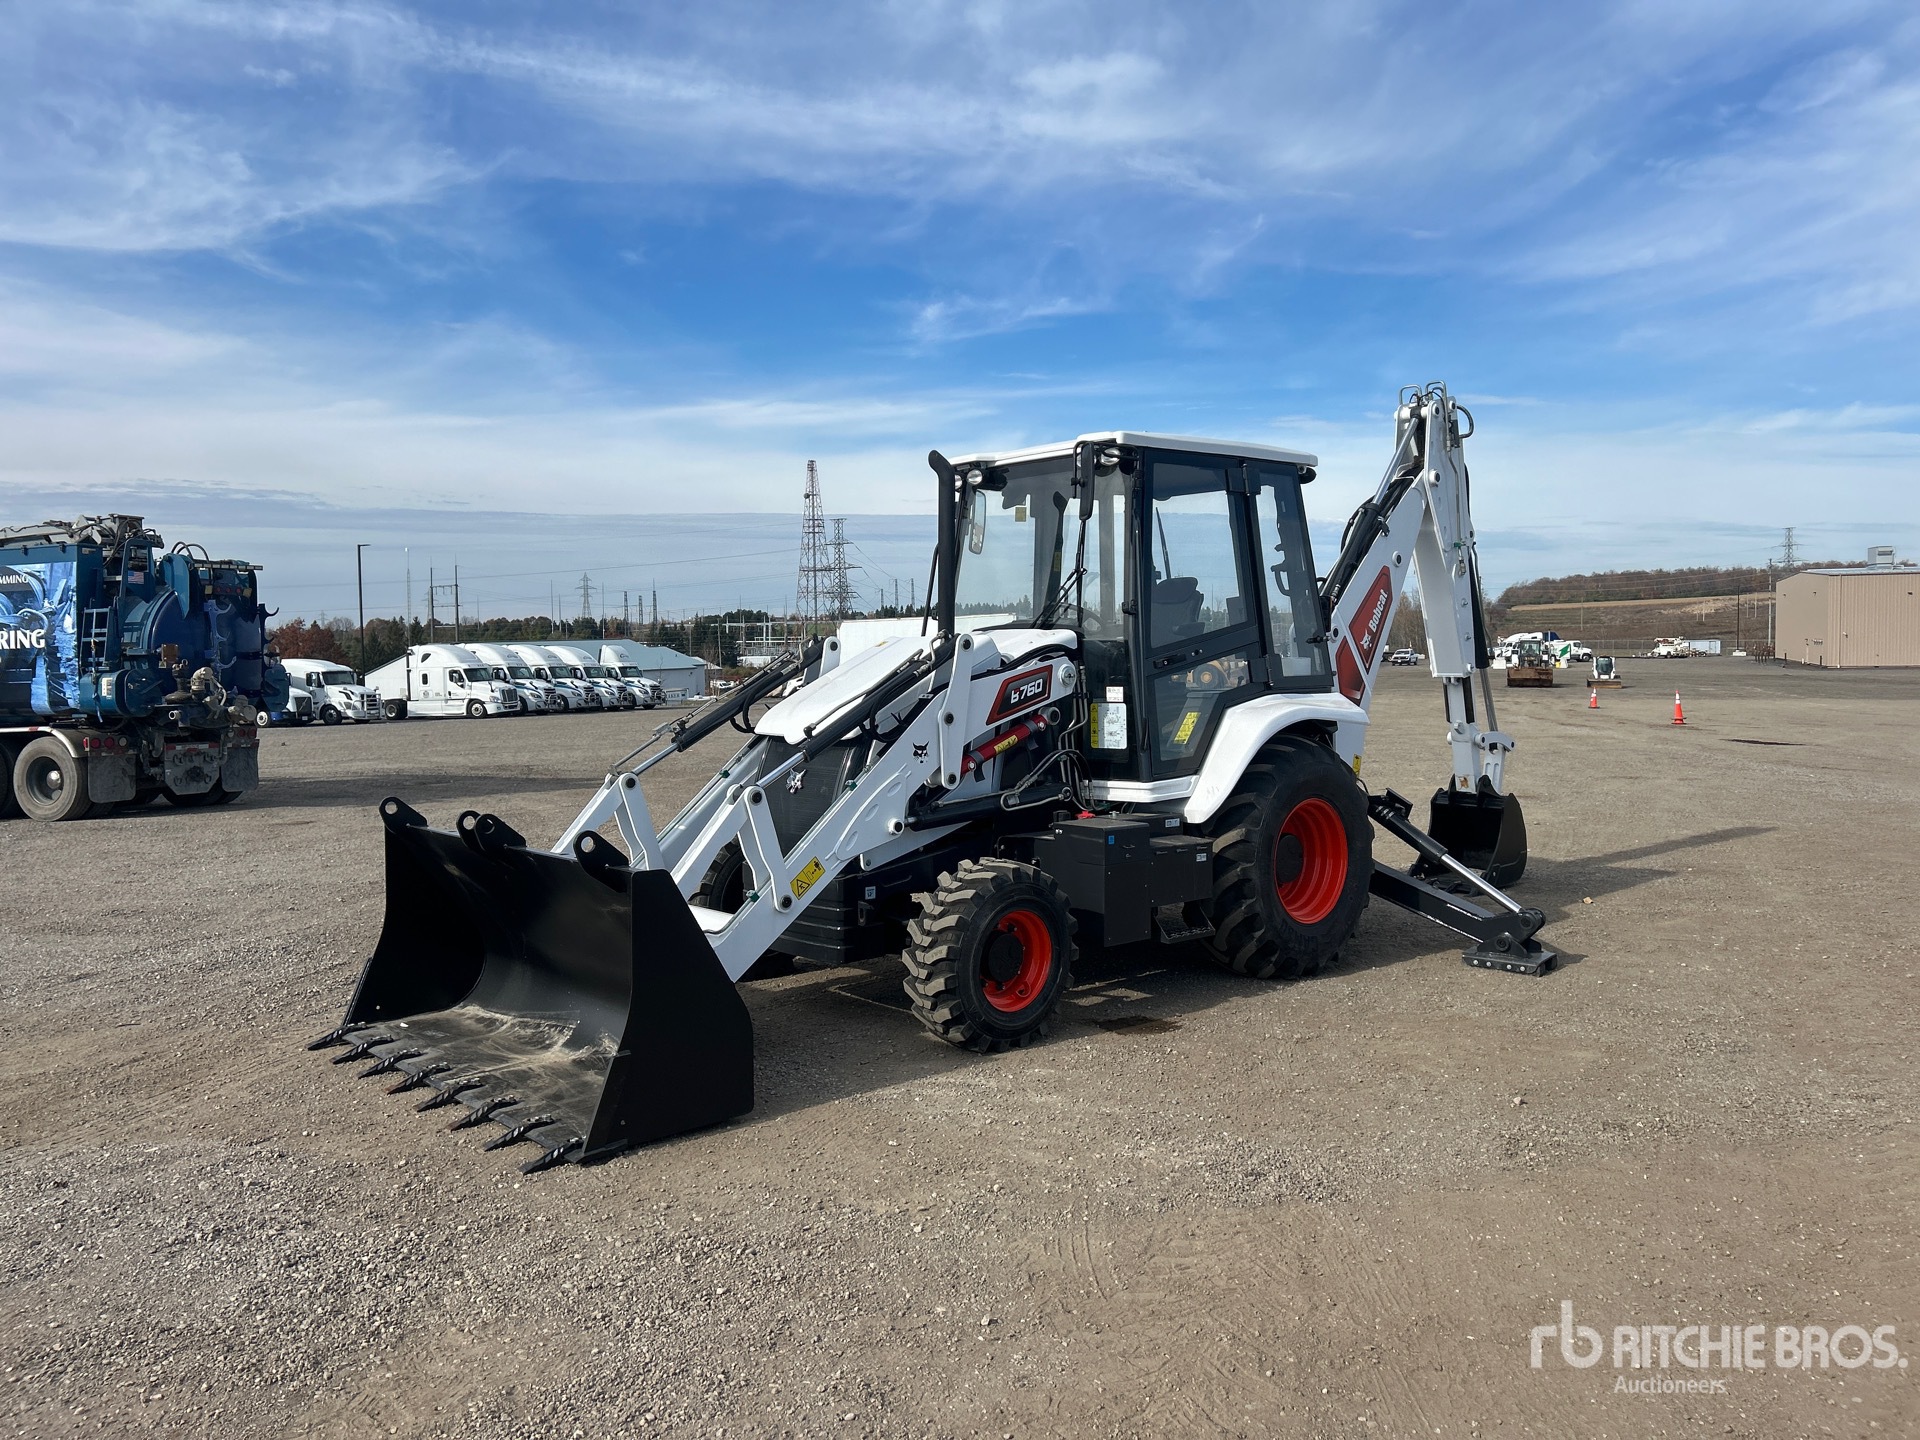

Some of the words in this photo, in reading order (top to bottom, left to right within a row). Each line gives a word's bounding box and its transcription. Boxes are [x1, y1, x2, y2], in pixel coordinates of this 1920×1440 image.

[1368, 588, 1388, 633] Bobcat
[0, 628, 46, 650] RING
[1010, 678, 1043, 704] B760
